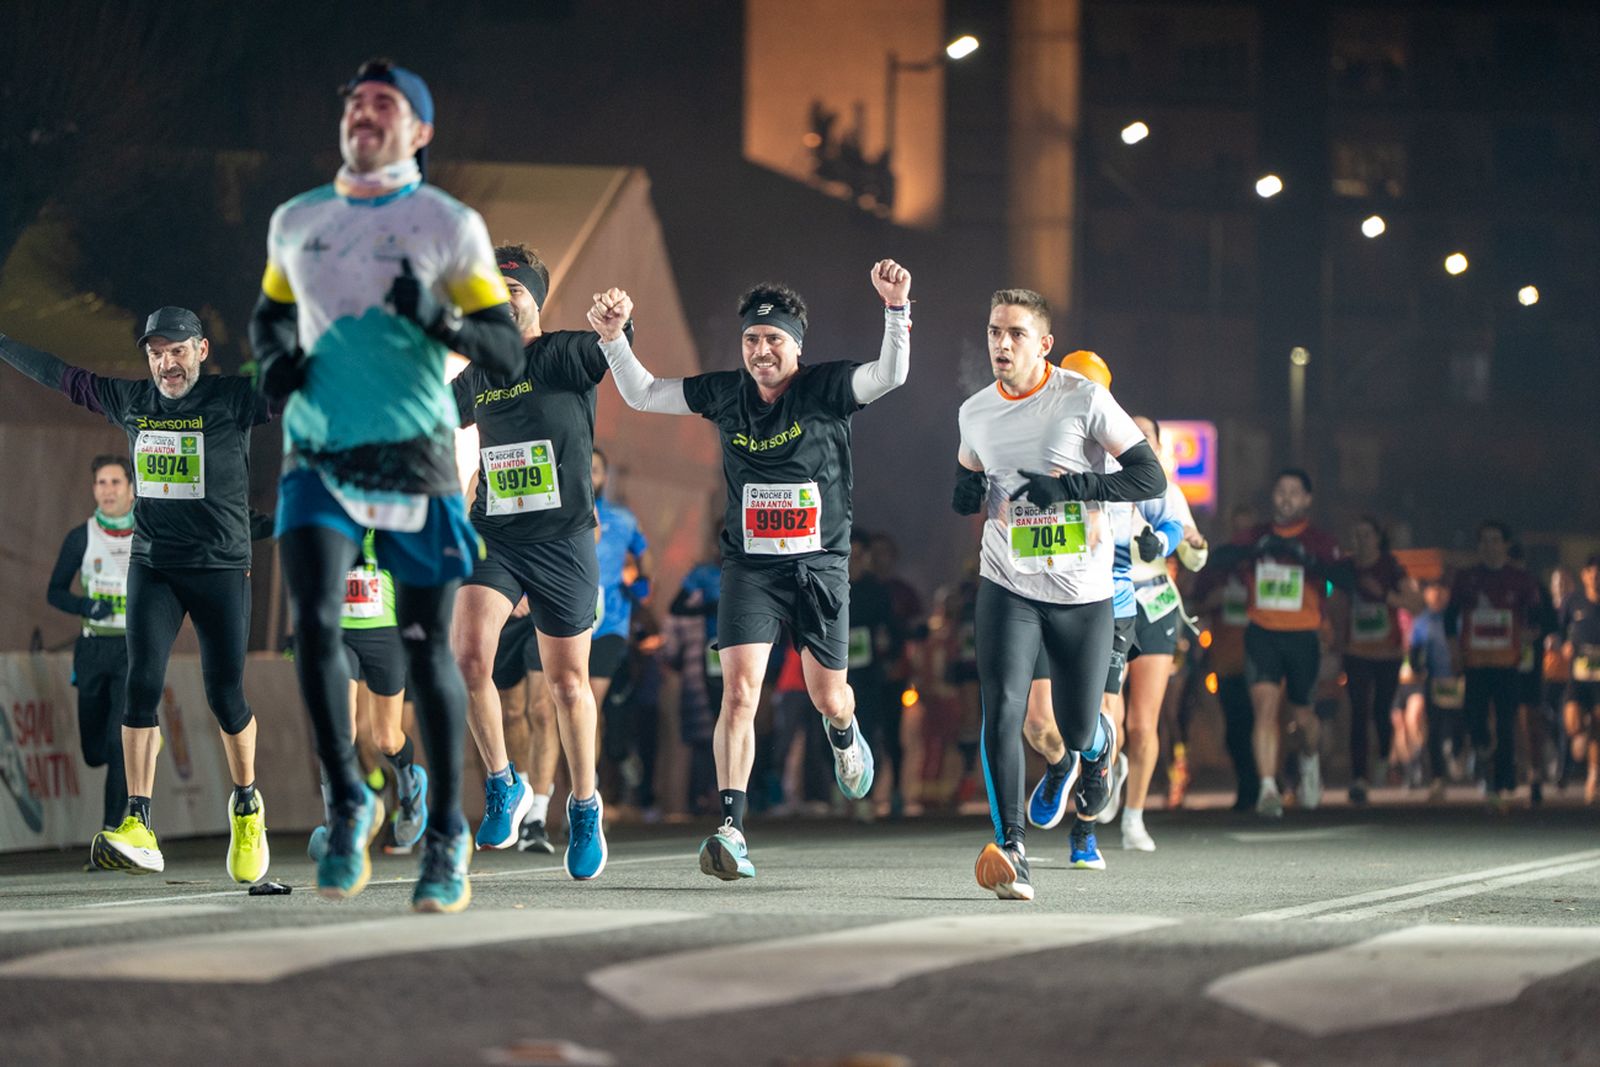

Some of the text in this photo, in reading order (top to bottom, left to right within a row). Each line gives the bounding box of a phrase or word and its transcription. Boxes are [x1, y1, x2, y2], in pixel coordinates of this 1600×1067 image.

[485, 379, 533, 405] personal
[148, 416, 203, 430] personal
[749, 421, 802, 452] personal
[147, 454, 188, 476] 9974
[490, 461, 500, 471] SAN
[495, 451, 515, 461] NOCHE
[516, 449, 525, 458] DE
[496, 466, 542, 491] 9979
[750, 500, 766, 508] SAN
[759, 491, 782, 499] NOCHE
[783, 491, 793, 499] DE
[756, 509, 808, 531] 9962
[1015, 517, 1032, 527] SAN
[1030, 525, 1067, 549] 704
[13, 701, 54, 747] SAN
